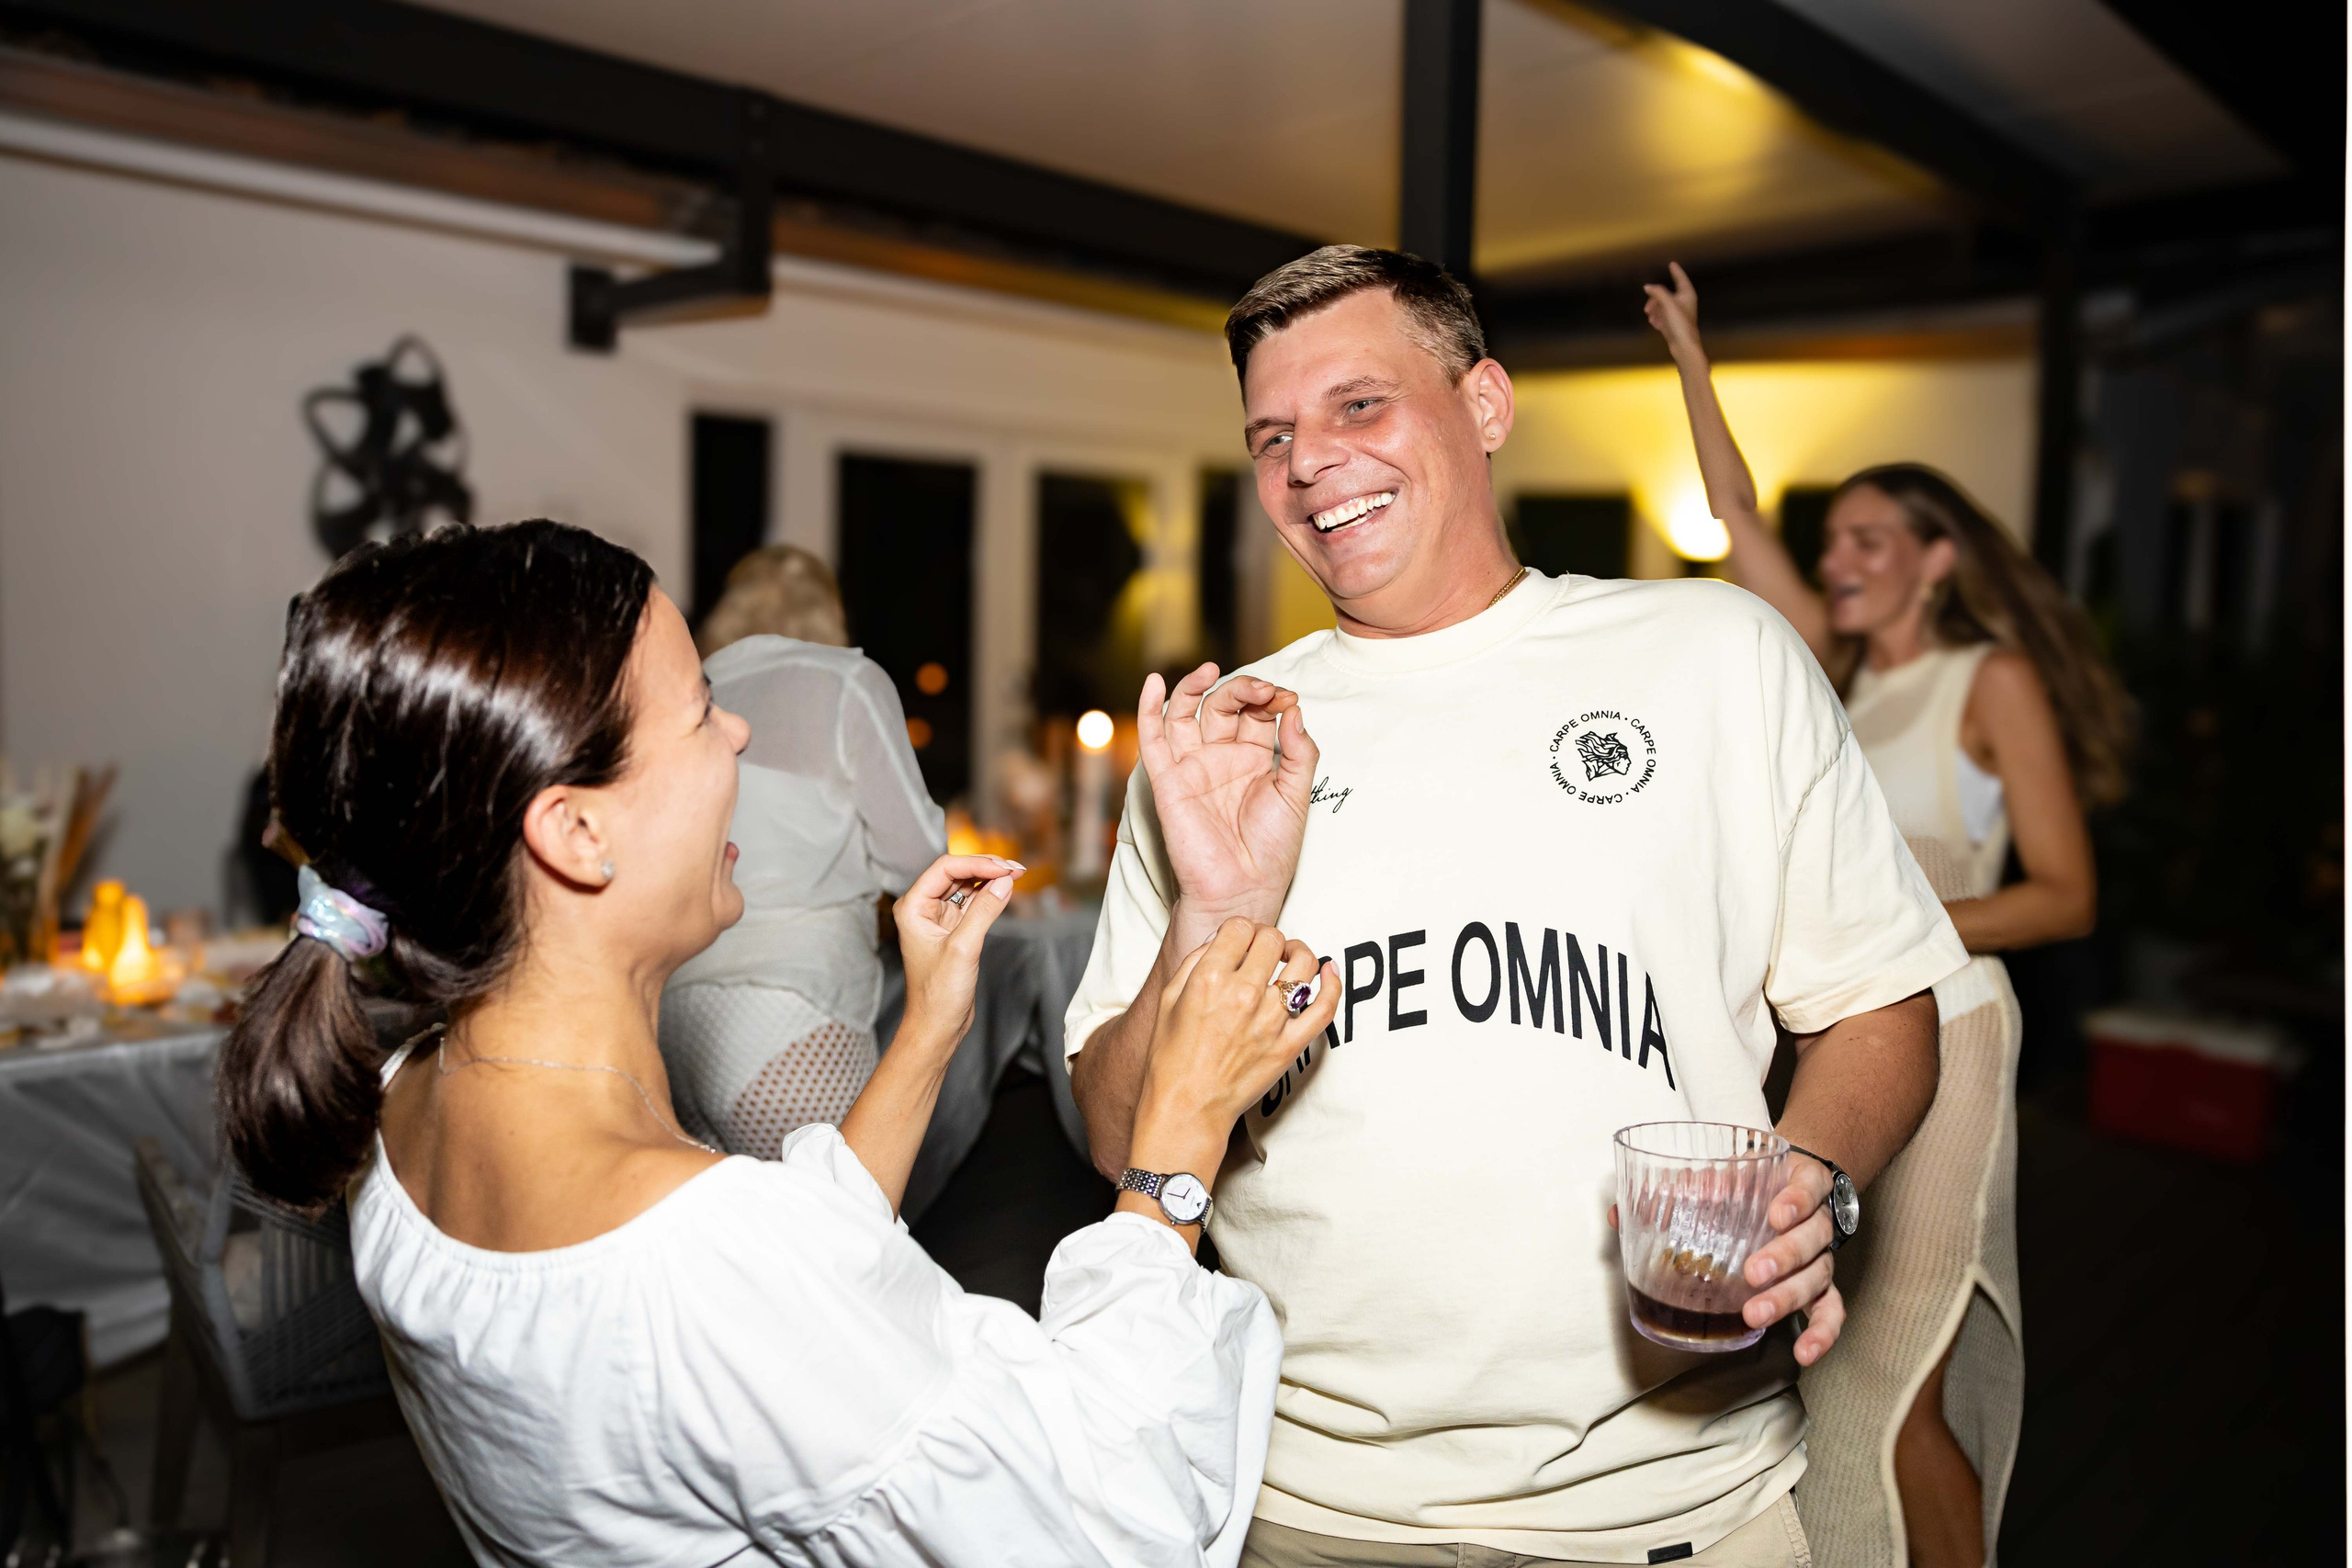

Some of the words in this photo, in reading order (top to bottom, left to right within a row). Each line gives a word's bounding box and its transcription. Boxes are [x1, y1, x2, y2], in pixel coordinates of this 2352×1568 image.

[1549, 718, 1579, 752] CARPE
[1580, 710, 1621, 722] OMNIA
[1630, 718, 1657, 755] CARPE
[1549, 761, 1577, 795] OMNIA
[1630, 759, 1657, 793] OMNIA
[1578, 791, 1623, 805] CARPE
[1451, 920, 1677, 1091] OMNIA
